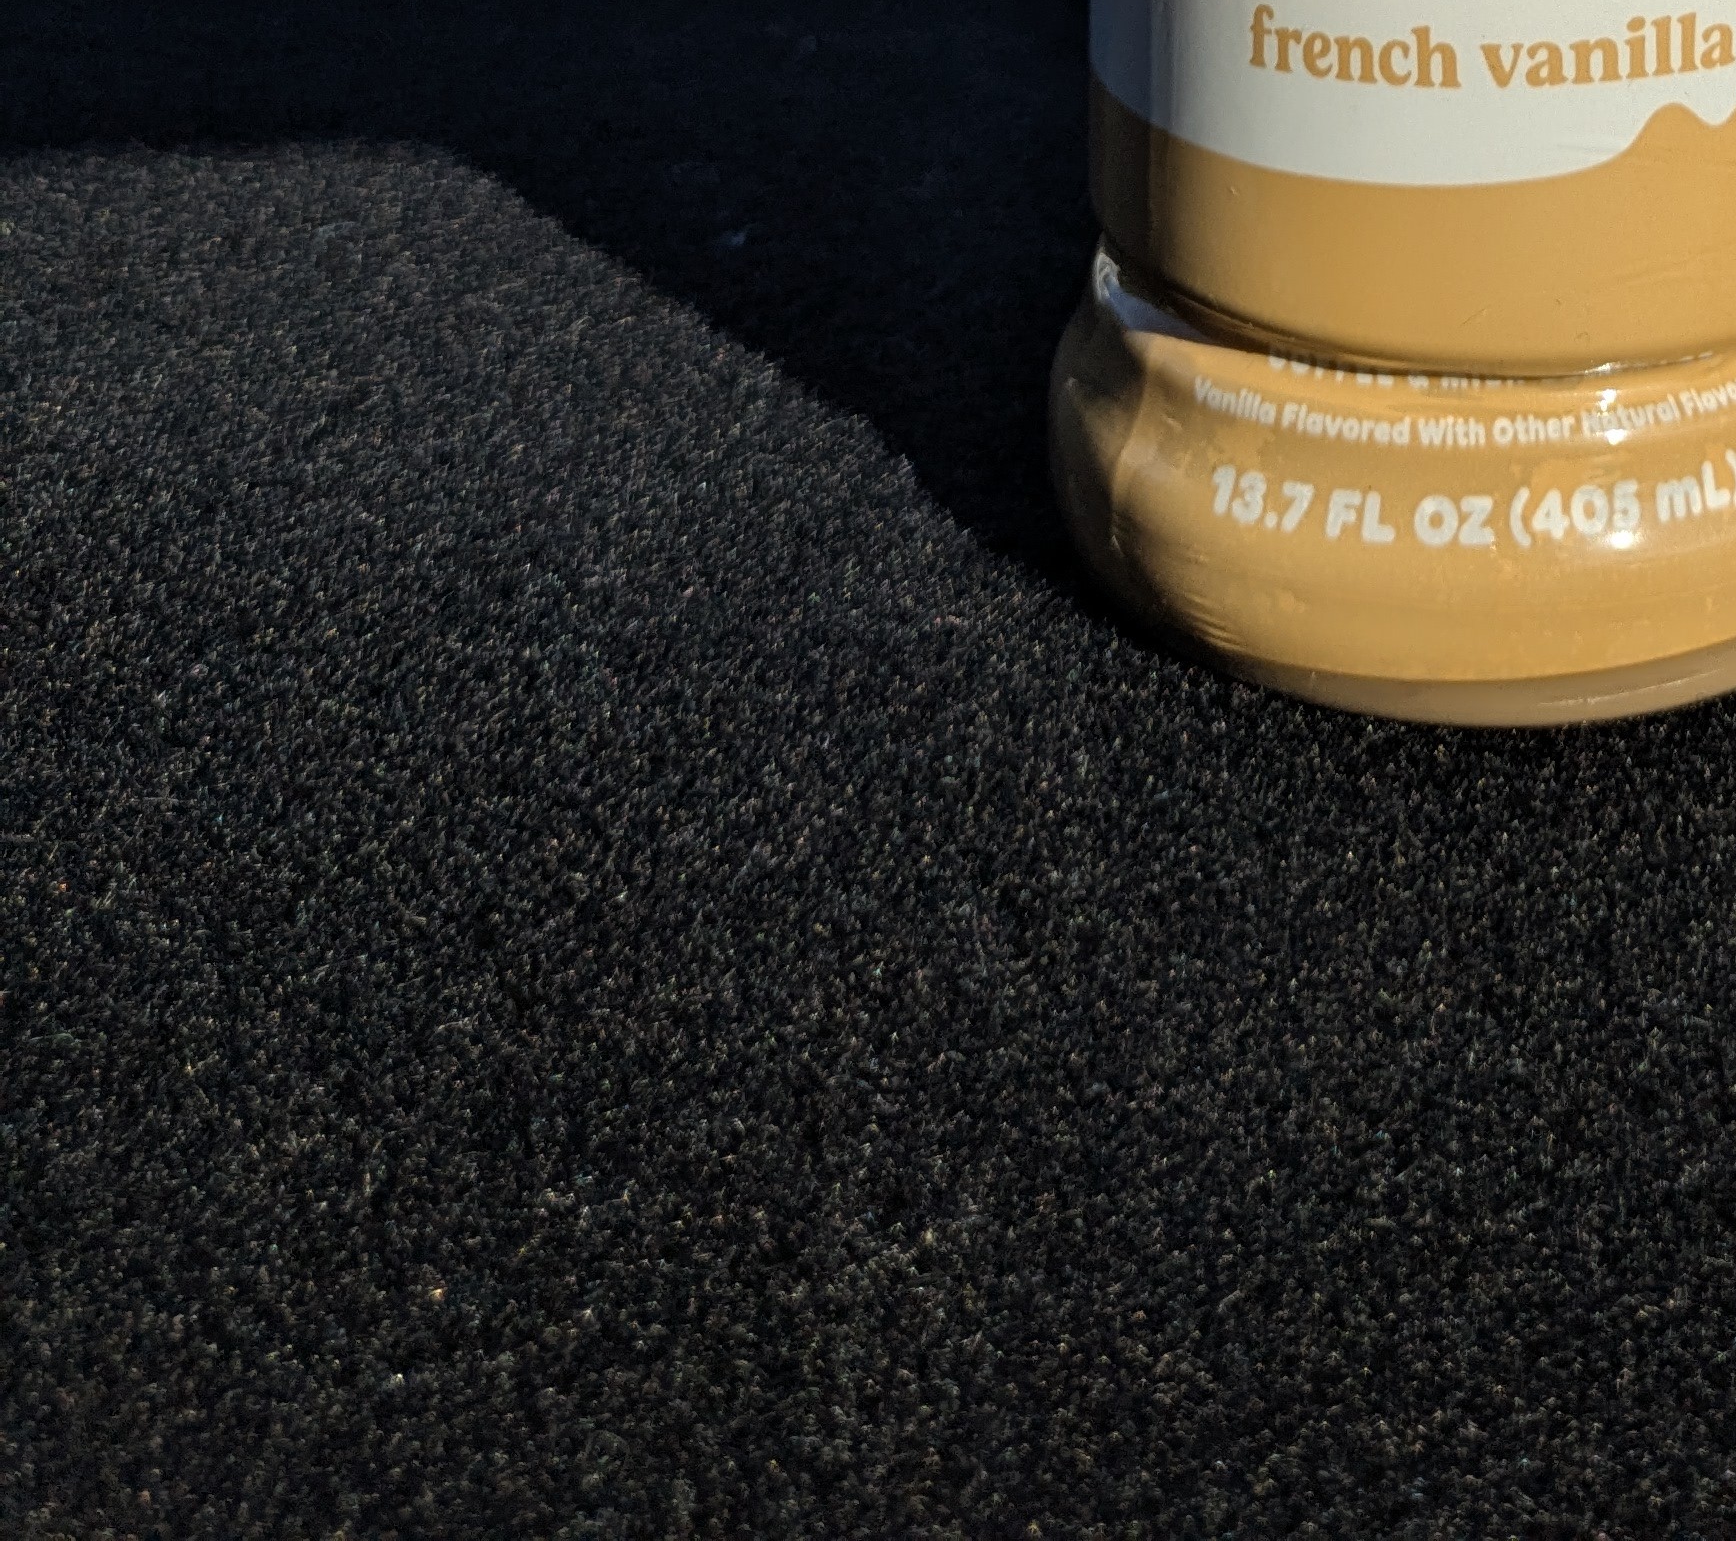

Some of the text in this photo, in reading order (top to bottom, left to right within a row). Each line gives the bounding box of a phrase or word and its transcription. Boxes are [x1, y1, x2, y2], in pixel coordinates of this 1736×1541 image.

[1247, 3, 1736, 88] french vanilla
[1194, 375, 1277, 427] Vanilla
[1281, 401, 1411, 445] Flavored
[1418, 415, 1486, 448] With
[1492, 413, 1576, 448] Other
[1580, 392, 1681, 439] Natural
[1211, 464, 1316, 533] 13.7
[1326, 488, 1396, 545] FL
[1413, 494, 1494, 548] OZ
[1509, 478, 1643, 548] (405
